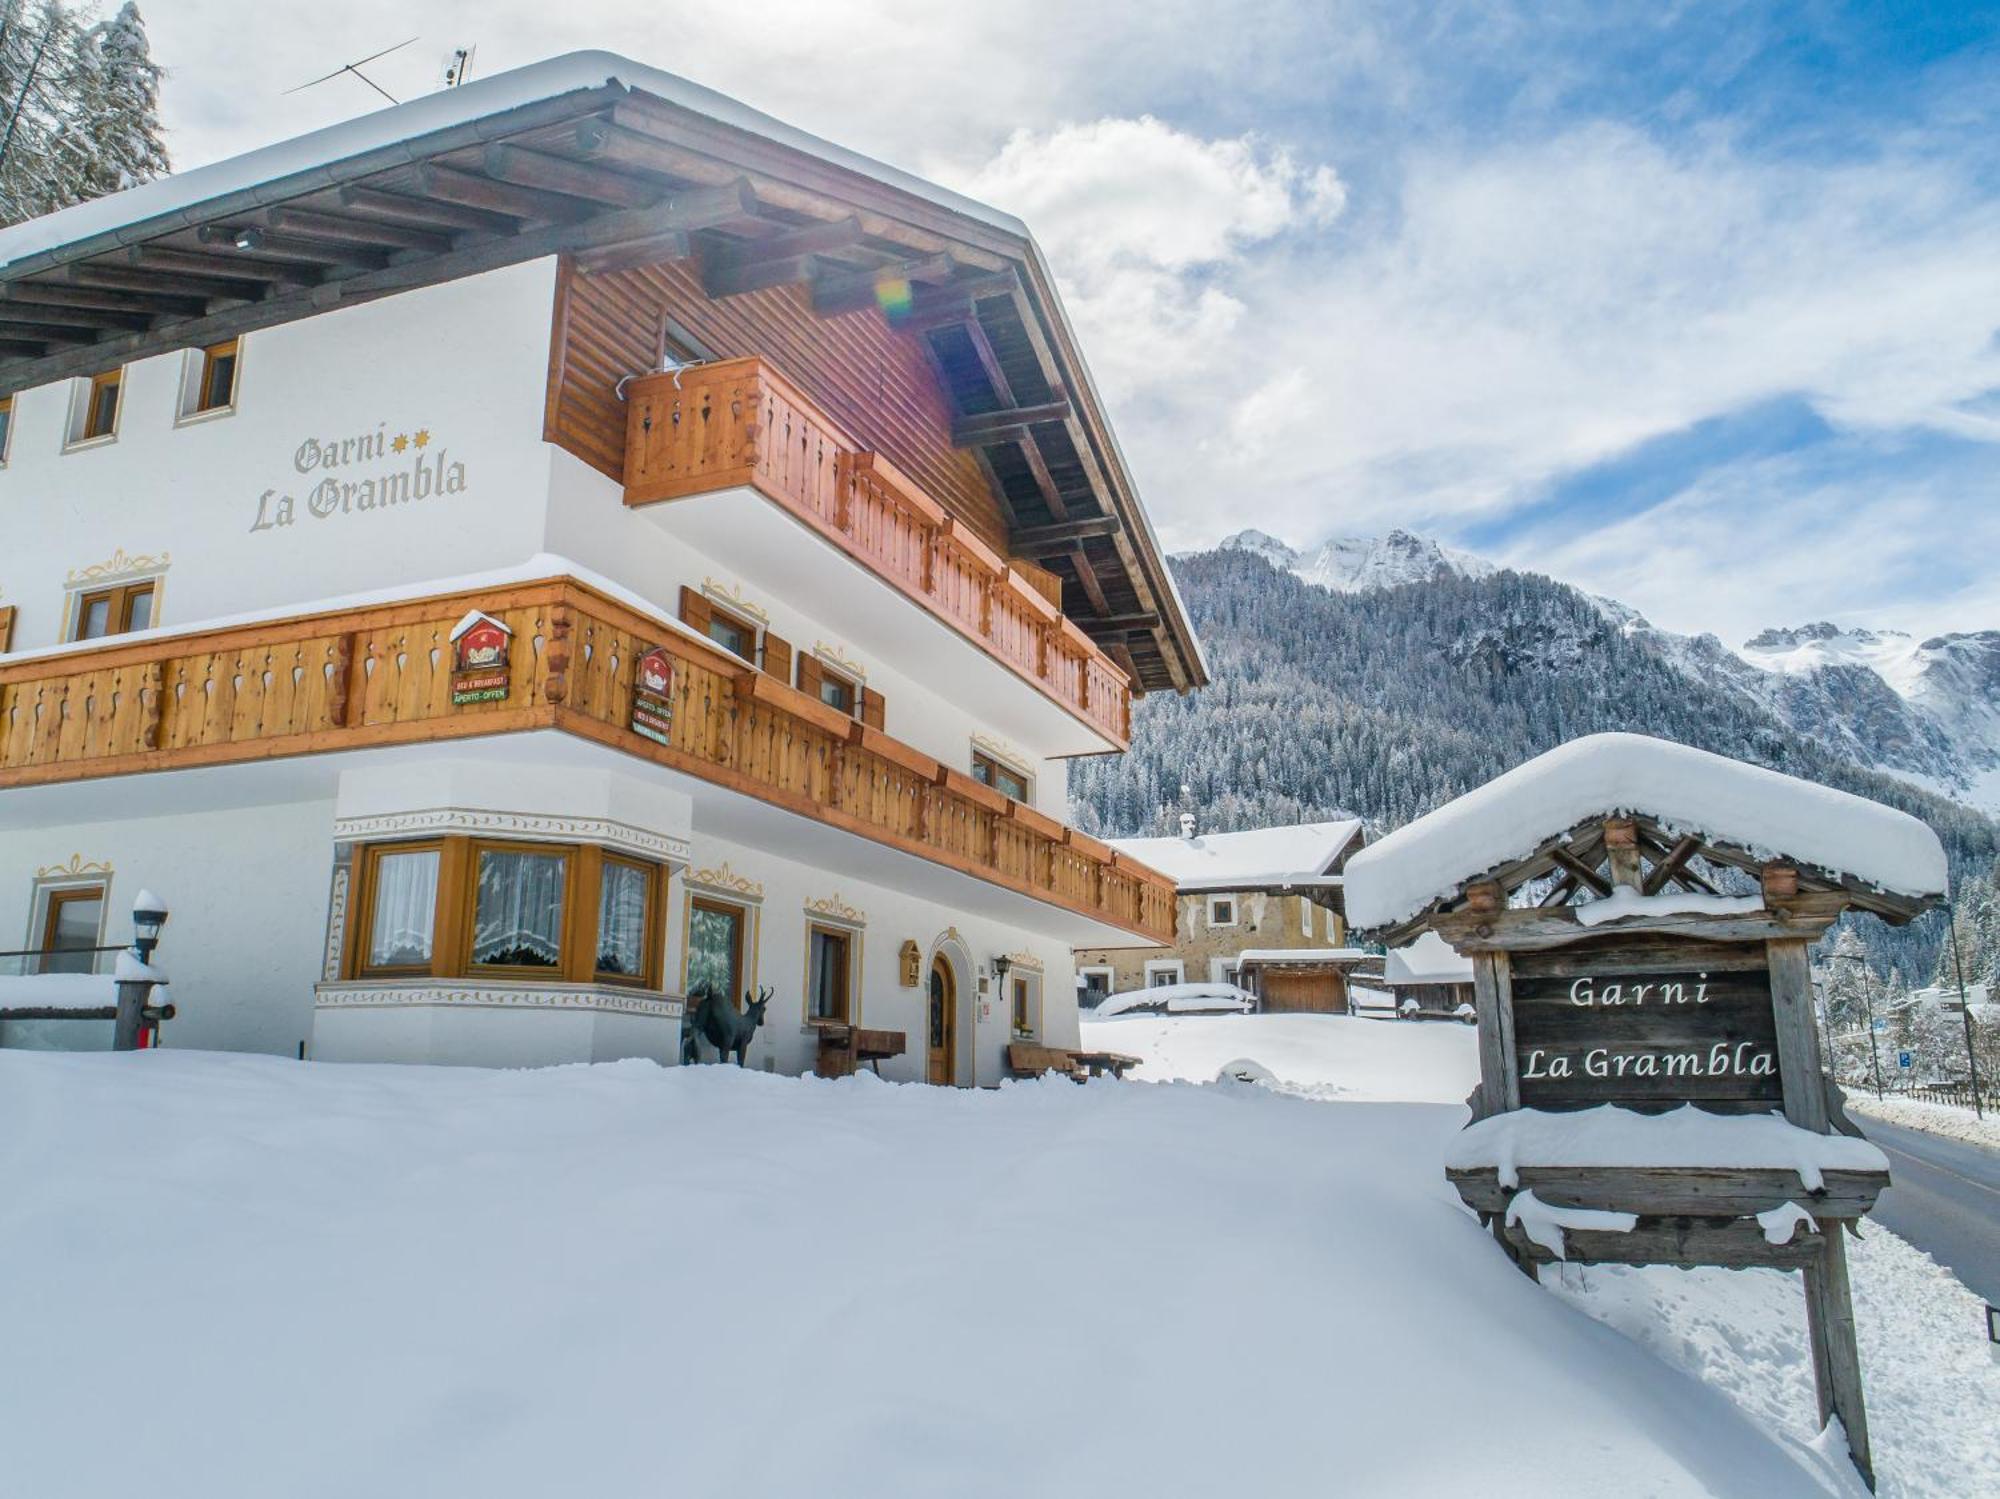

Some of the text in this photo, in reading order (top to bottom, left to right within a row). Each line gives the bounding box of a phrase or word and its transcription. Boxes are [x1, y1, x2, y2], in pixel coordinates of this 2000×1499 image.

[294, 421, 387, 474] Garni
[249, 448, 468, 533] La Grambla
[1570, 972, 1709, 1007] Garni
[1522, 1042, 1777, 1079] La Grambla
